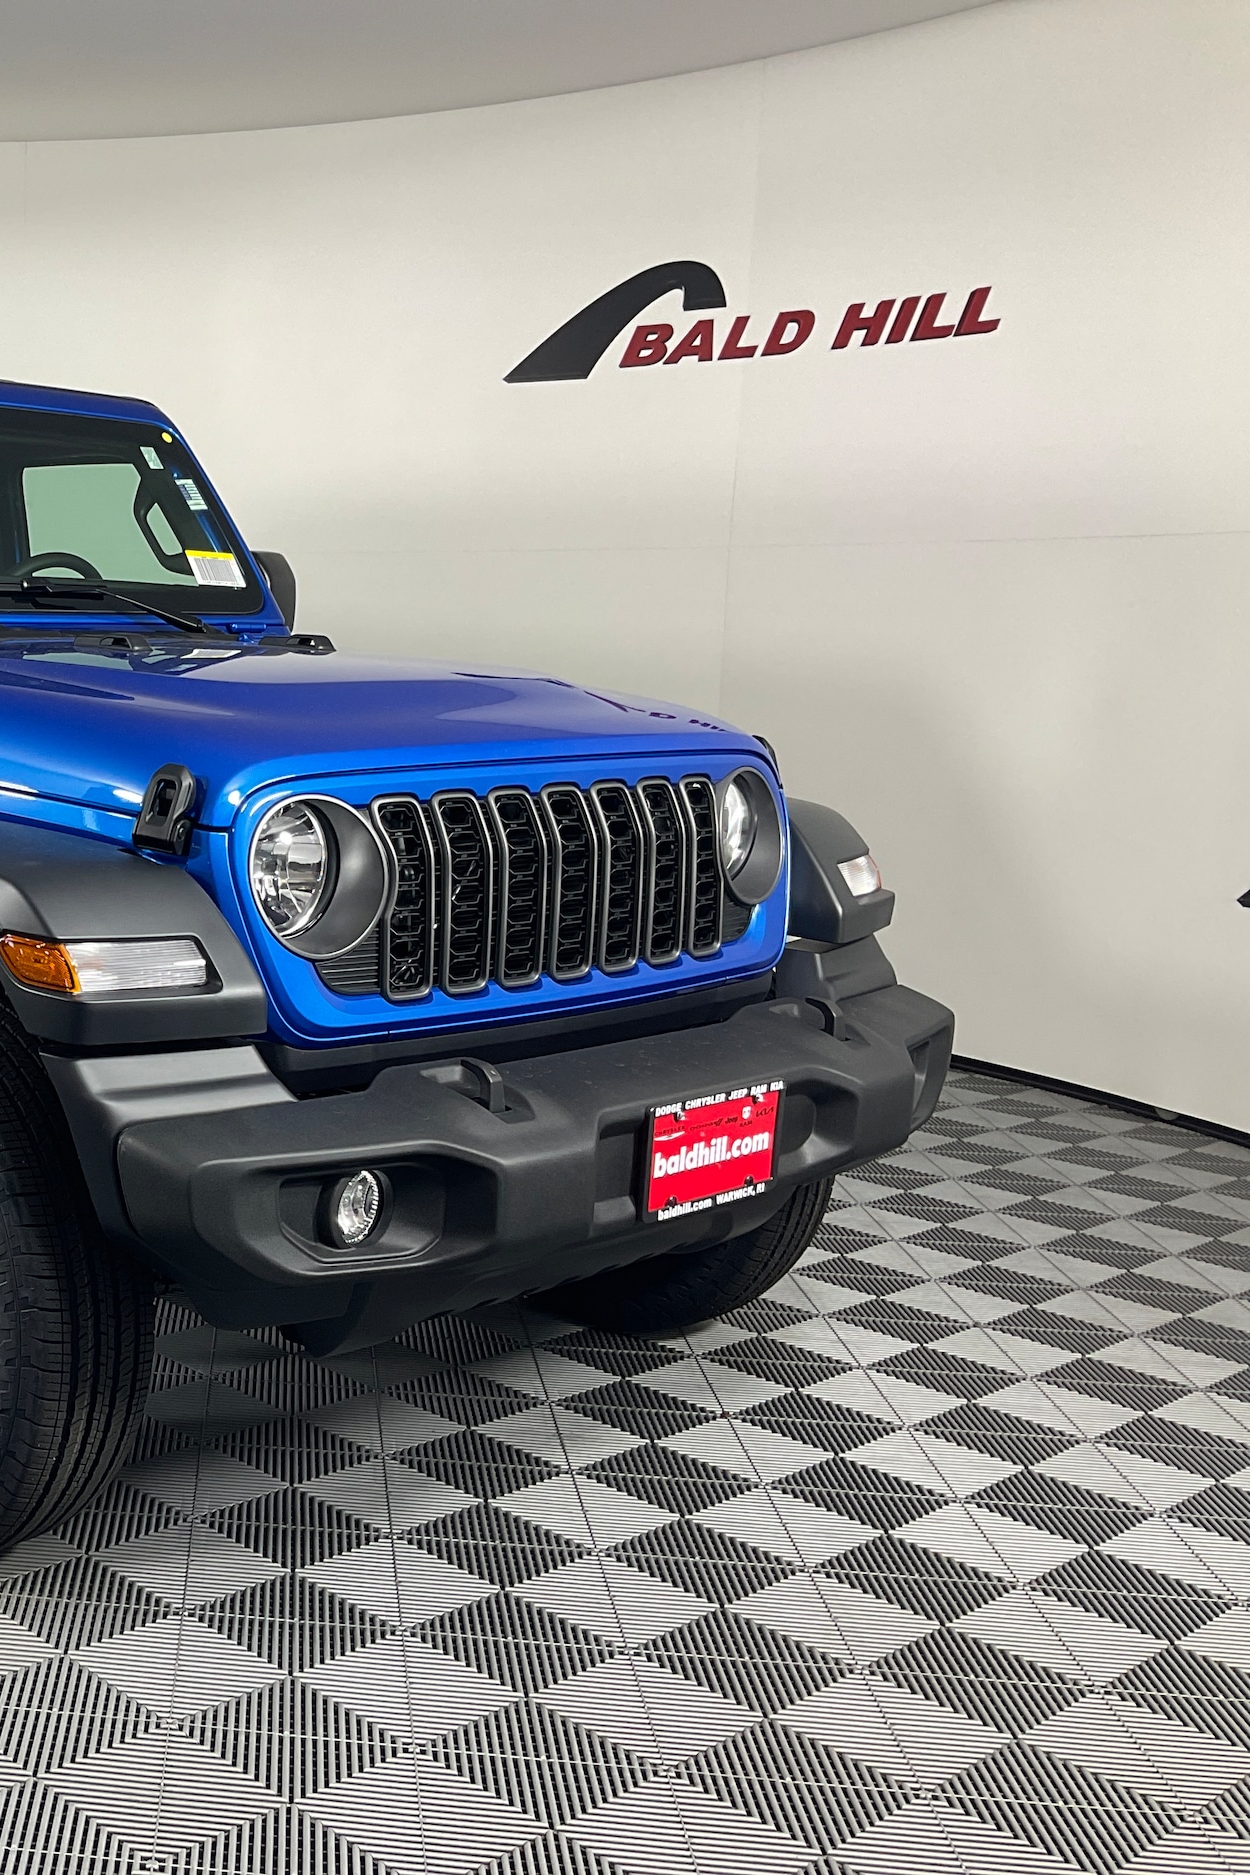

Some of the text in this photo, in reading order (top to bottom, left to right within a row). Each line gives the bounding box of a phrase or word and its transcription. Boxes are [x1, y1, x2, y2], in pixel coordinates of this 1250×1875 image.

[618, 286, 1002, 369] BALD HILL
[655, 1080, 784, 1118] DODGE CHRYSLER JEEP RAM KIA
[653, 1131, 770, 1179] baldhill.com
[657, 1182, 766, 1221] baldhill.com WARWICK, RI
